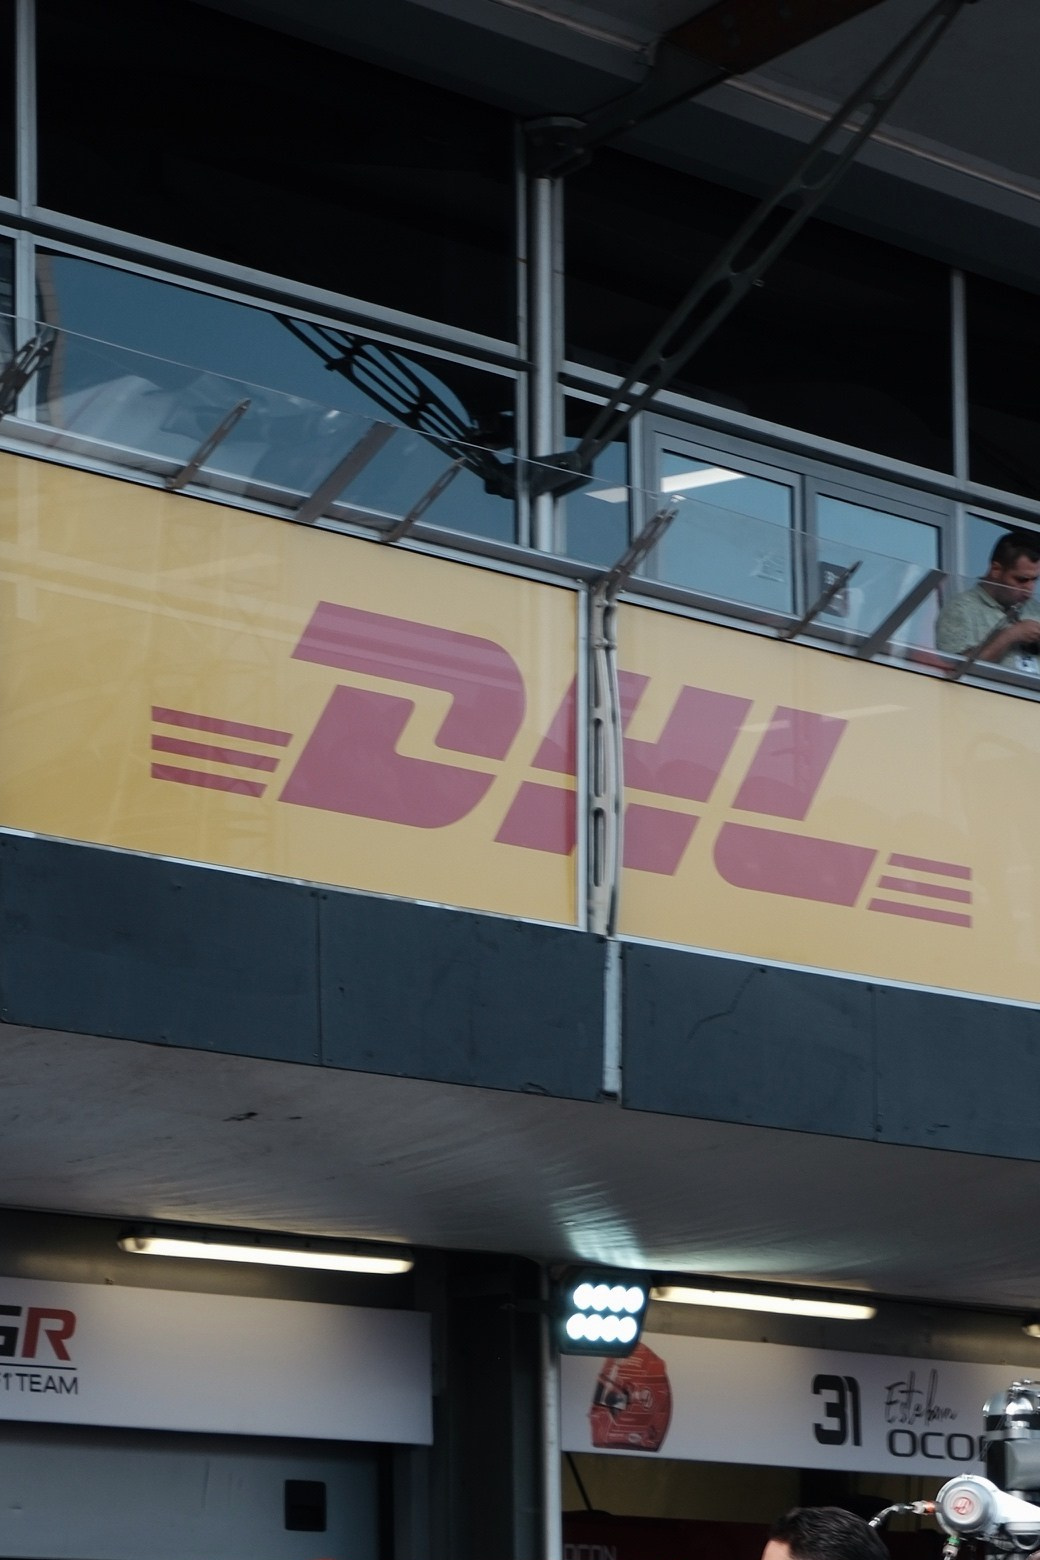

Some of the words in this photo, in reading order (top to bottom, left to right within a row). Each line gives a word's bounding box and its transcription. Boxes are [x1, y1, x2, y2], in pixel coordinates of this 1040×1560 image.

[278, 600, 877, 908] DHL
[15, 1373, 78, 1395] TEAM
[811, 1373, 863, 1447] 31
